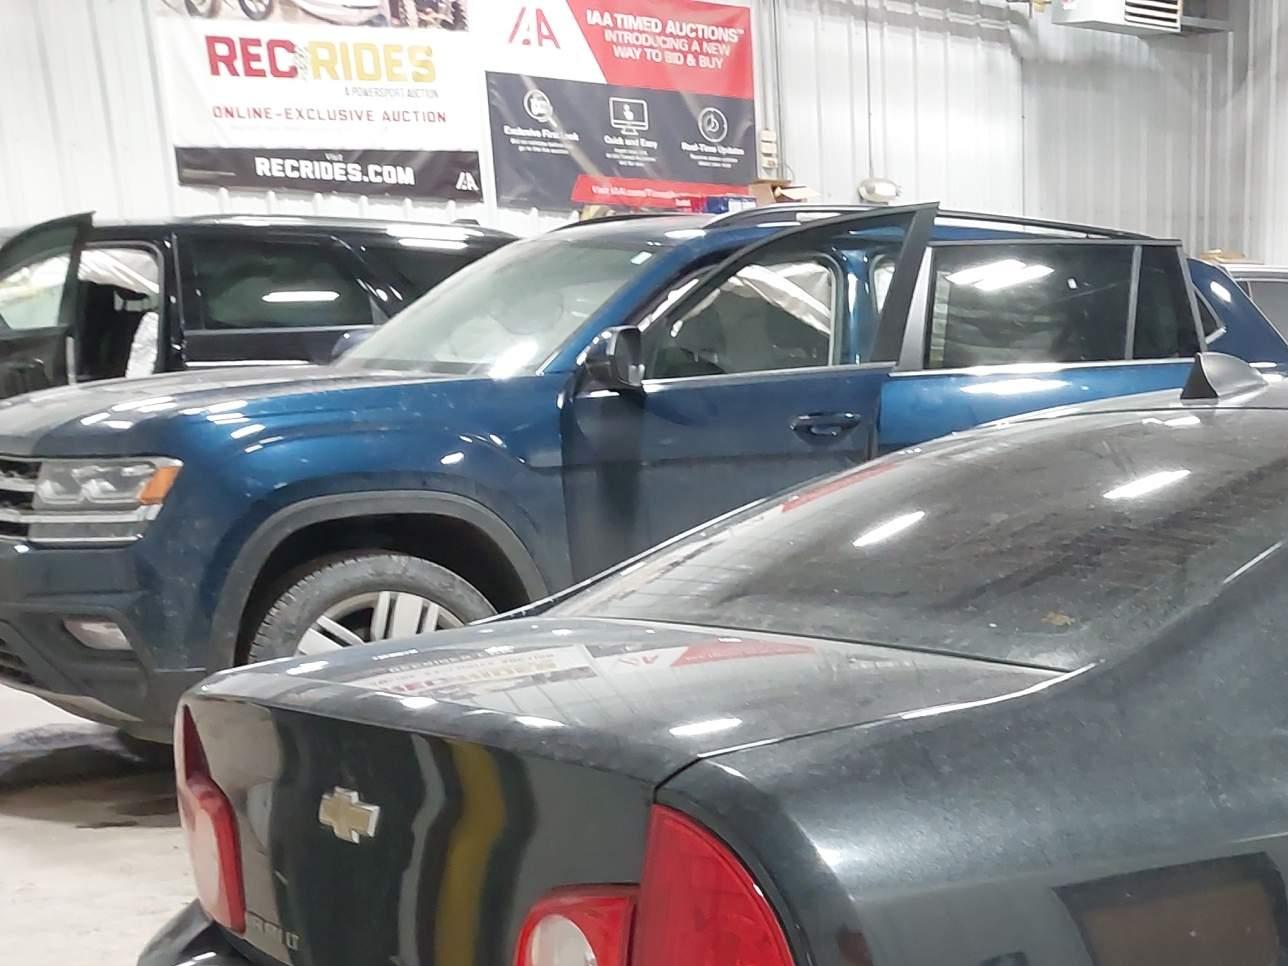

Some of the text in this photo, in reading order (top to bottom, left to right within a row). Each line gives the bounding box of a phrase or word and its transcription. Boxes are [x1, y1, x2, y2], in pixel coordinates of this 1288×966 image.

[586, 9, 613, 27] IAA
[613, 13, 663, 33] TIMED
[604, 29, 732, 57] INTRODUCING A NEW
[205, 35, 437, 83] REC RIDES
[612, 45, 724, 70] WAY TO BID & BUY
[212, 105, 447, 123] ONLINE-EXCLUSIVE AUCTION
[254, 156, 416, 186] RECRIDES.COM
